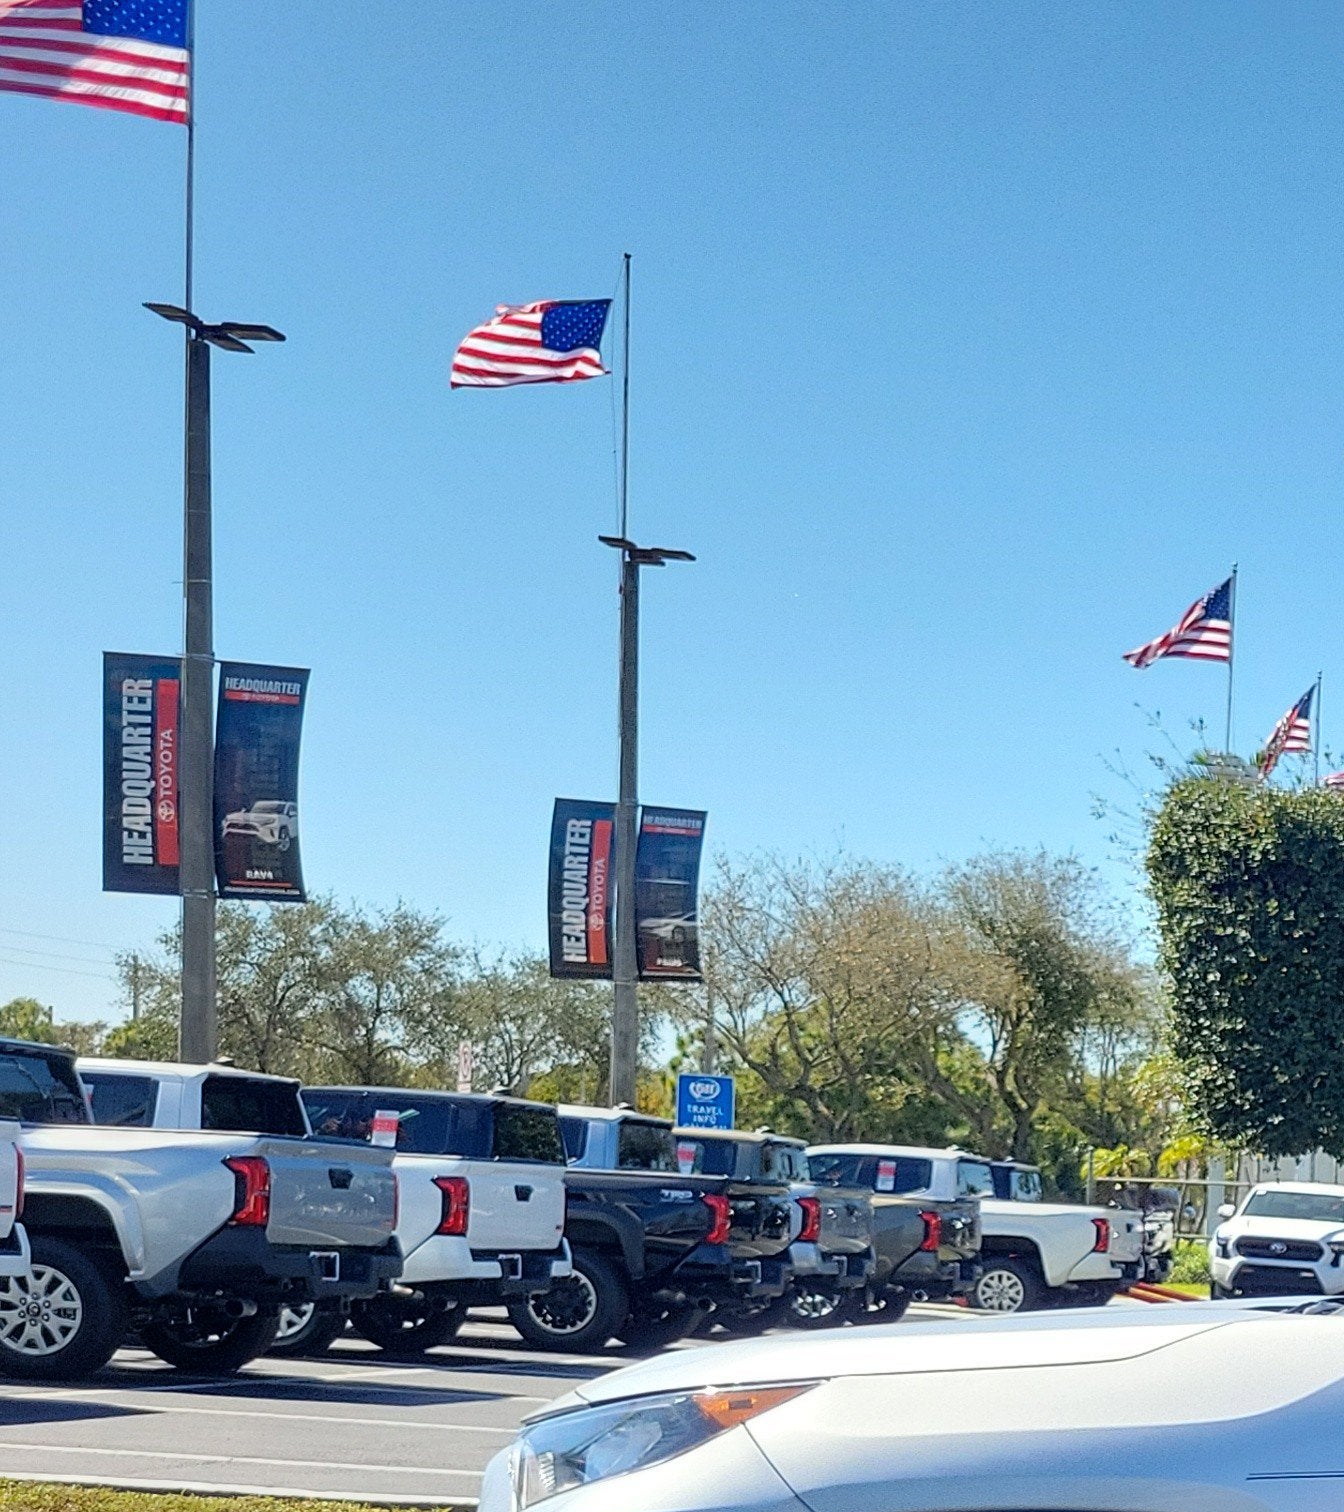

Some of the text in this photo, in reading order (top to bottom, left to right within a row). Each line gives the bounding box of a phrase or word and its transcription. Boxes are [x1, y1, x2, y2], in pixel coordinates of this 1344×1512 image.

[225, 677, 301, 695] HEADQUARTER
[122, 678, 155, 865] HEADQUARTER
[160, 728, 173, 798] TOYOTA
[562, 818, 592, 963] HEADQUARTER
[593, 858, 606, 910] TOYOTA
